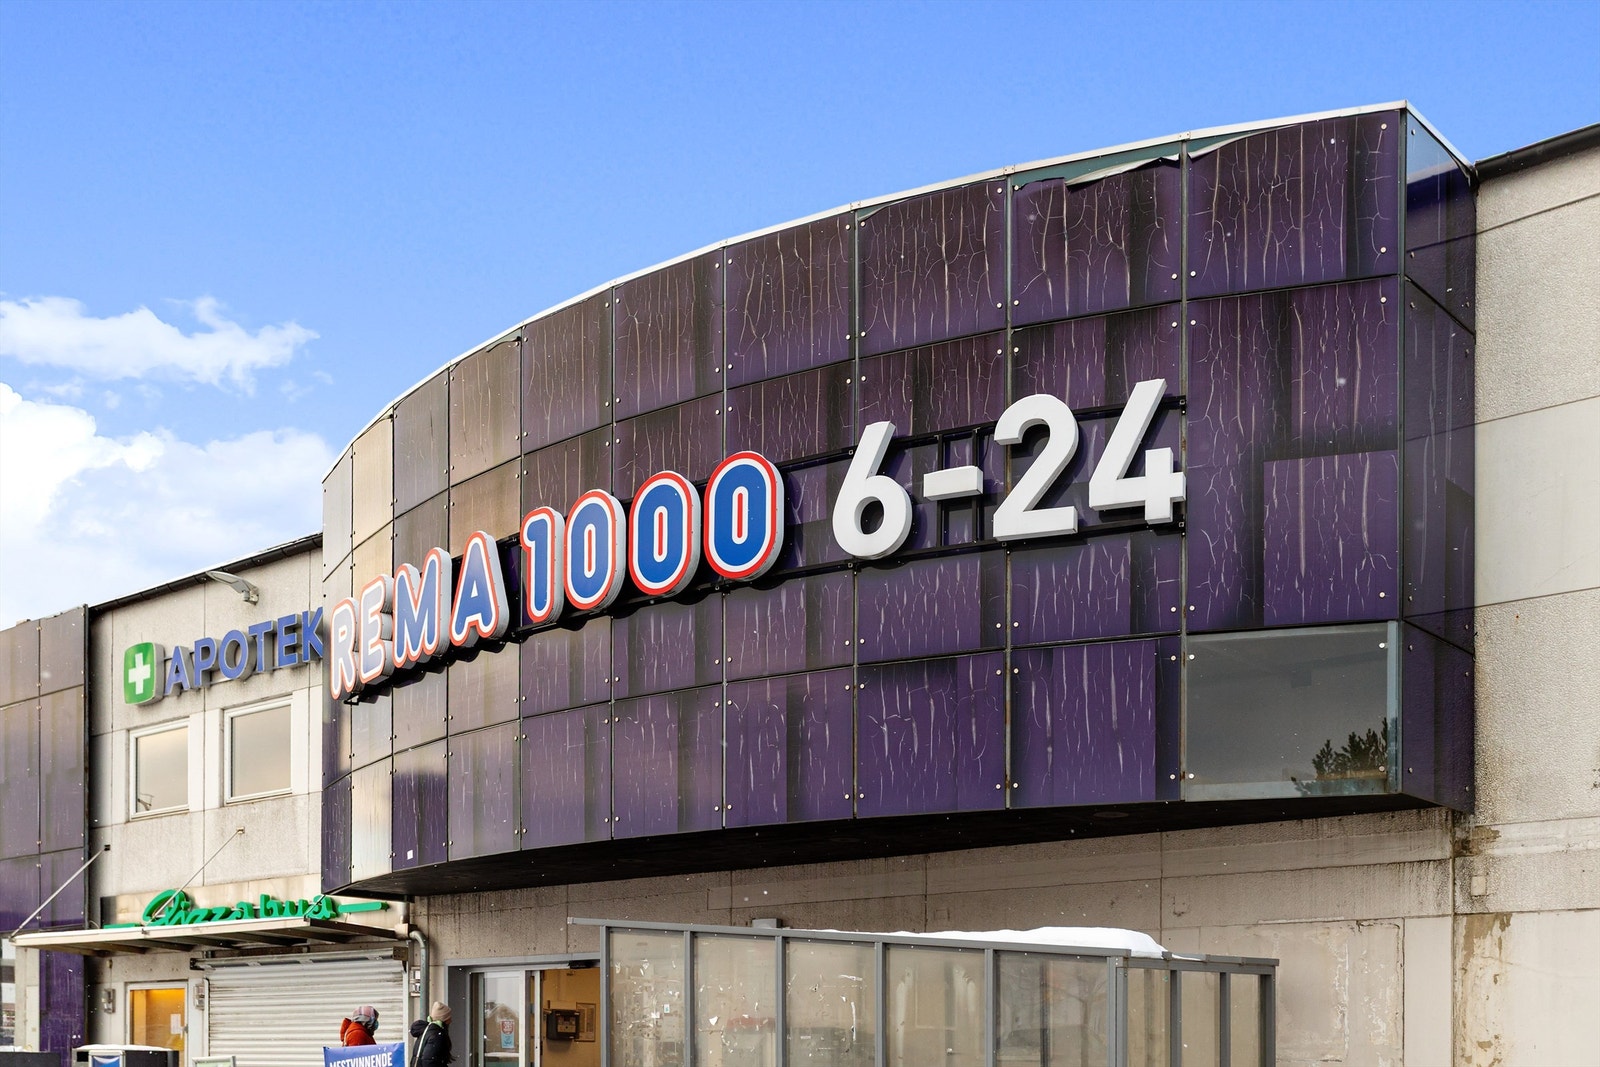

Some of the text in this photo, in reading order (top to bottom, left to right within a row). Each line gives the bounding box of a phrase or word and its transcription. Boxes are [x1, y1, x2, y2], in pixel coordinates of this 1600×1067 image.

[330, 378, 1186, 699] REMA 1000 6-24
[165, 607, 323, 696] APOTEK
